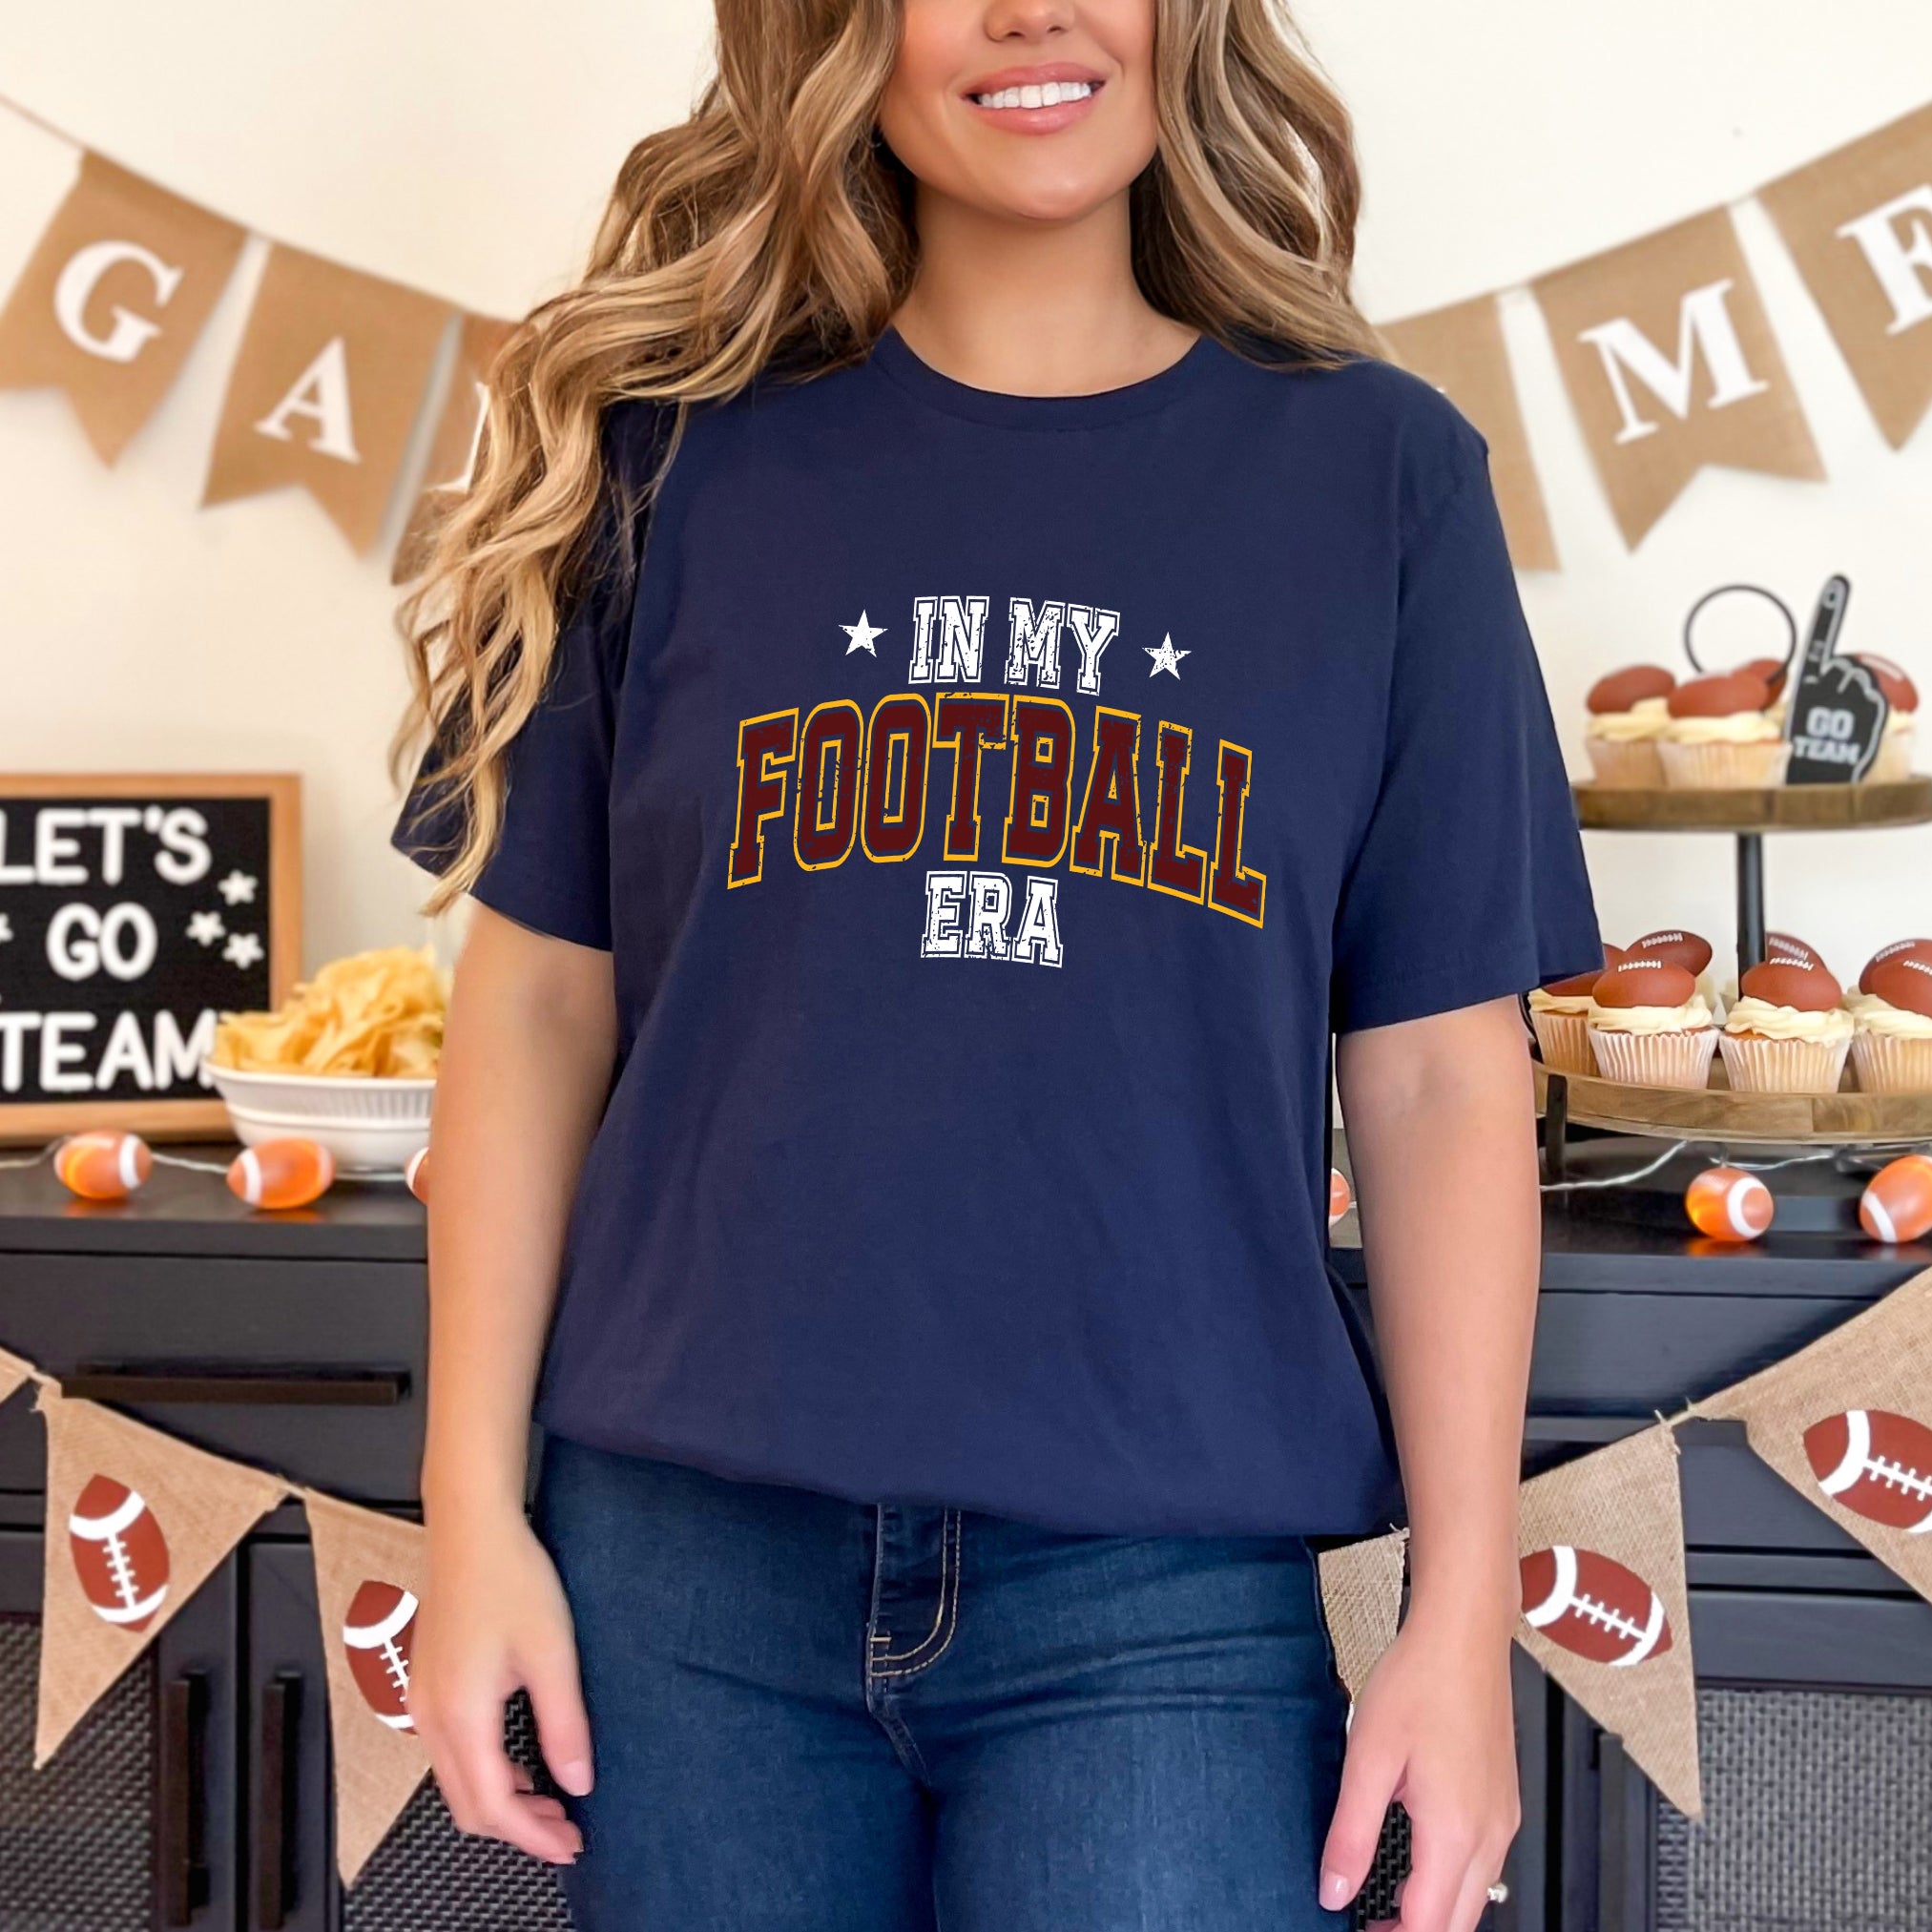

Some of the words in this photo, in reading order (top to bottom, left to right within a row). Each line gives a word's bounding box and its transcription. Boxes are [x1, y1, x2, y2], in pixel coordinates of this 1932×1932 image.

[908, 595, 989, 684] IN
[1005, 597, 1120, 696] MY
[1793, 735, 1860, 763] TEAM
[1806, 707, 1854, 740] GO
[0, 805, 212, 885] LET'S
[727, 692, 1267, 929] FOOTBALL
[46, 902, 157, 981] GO
[921, 870, 1063, 967] ERA
[0, 1008, 218, 1091] TEAM
